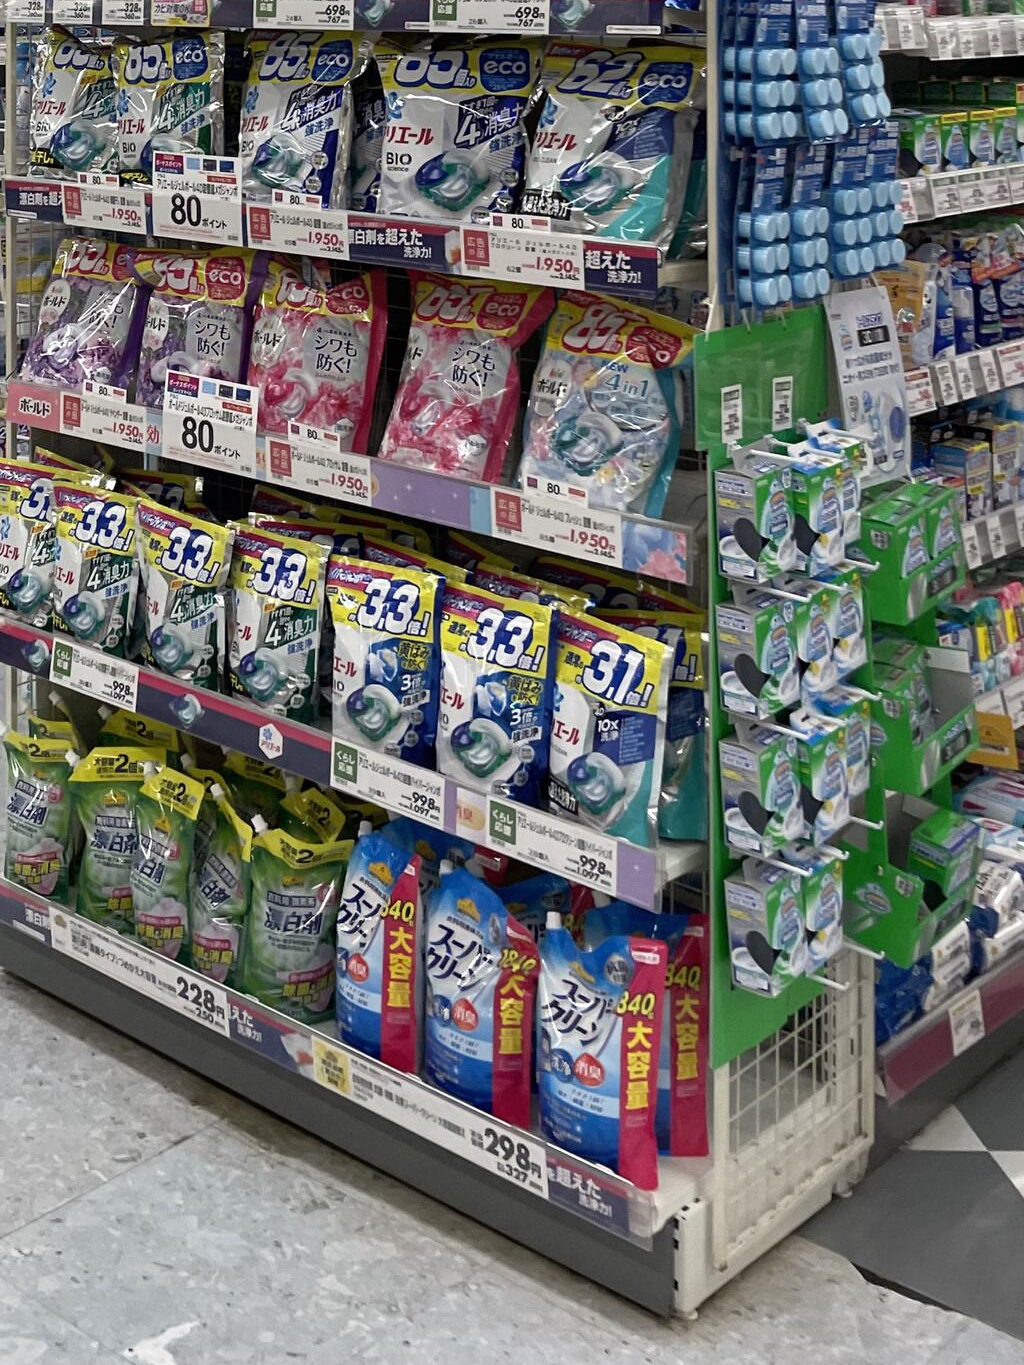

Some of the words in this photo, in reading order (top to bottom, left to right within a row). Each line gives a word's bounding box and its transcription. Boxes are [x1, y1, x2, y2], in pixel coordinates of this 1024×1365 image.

[515, 7, 545, 19] 698円
[176, 45, 203, 64] eco
[317, 53, 349, 67] eco
[484, 60, 526, 75] eco
[643, 74, 687, 88] eco
[122, 142, 136, 153] BIO
[386, 152, 412, 166] BIO
[512, 218, 524, 228] 80
[585, 250, 631, 270] 超えた
[208, 269, 243, 285] eco
[43, 295, 67, 307] ボールド
[485, 302, 520, 316] eco
[195, 320, 231, 341] シワも
[197, 337, 225, 358] 防ぐ!
[314, 335, 358, 358] シワも
[316, 353, 352, 374] 防ぐ!
[452, 348, 495, 371] シワも
[452, 365, 488, 387] 防ぐ!
[98, 386, 107, 396] 80
[19, 398, 51, 416] ボールド
[547, 483, 560, 494] 80
[284, 614, 314, 639] 消臭力
[56, 649, 70, 660] くらし
[336, 749, 356, 763] くらし
[338, 761, 354, 776] 応援
[493, 808, 514, 824] くらし
[494, 821, 513, 836] 応援
[579, 854, 612, 876] 998円
[388, 927, 414, 1008] 大容量
[176, 976, 226, 1021] 228円
[499, 975, 526, 1054] 大容量
[676, 994, 701, 1080] 大容量
[575, 1059, 602, 1080] 消臭
[626, 1021, 653, 1110] 大容量
[484, 1127, 542, 1180] 298円
[505, 1162, 528, 1183] 327
